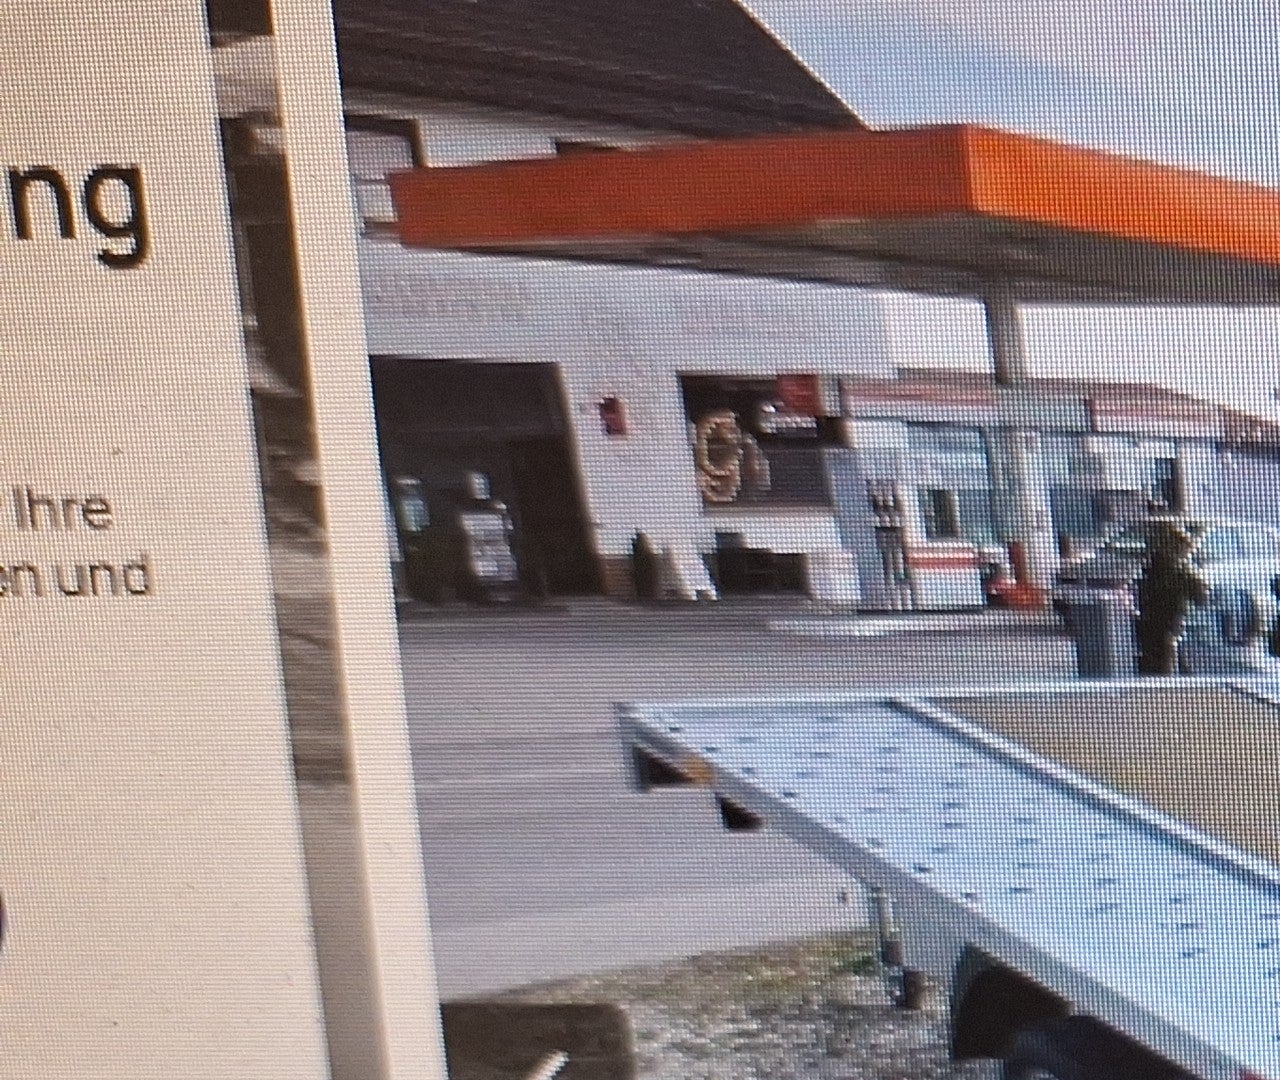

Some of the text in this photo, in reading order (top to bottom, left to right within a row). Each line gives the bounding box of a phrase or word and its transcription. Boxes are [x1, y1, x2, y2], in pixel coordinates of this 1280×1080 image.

[8, 163, 150, 270] ng
[13, 484, 113, 532] Ihre
[53, 550, 155, 598] und
